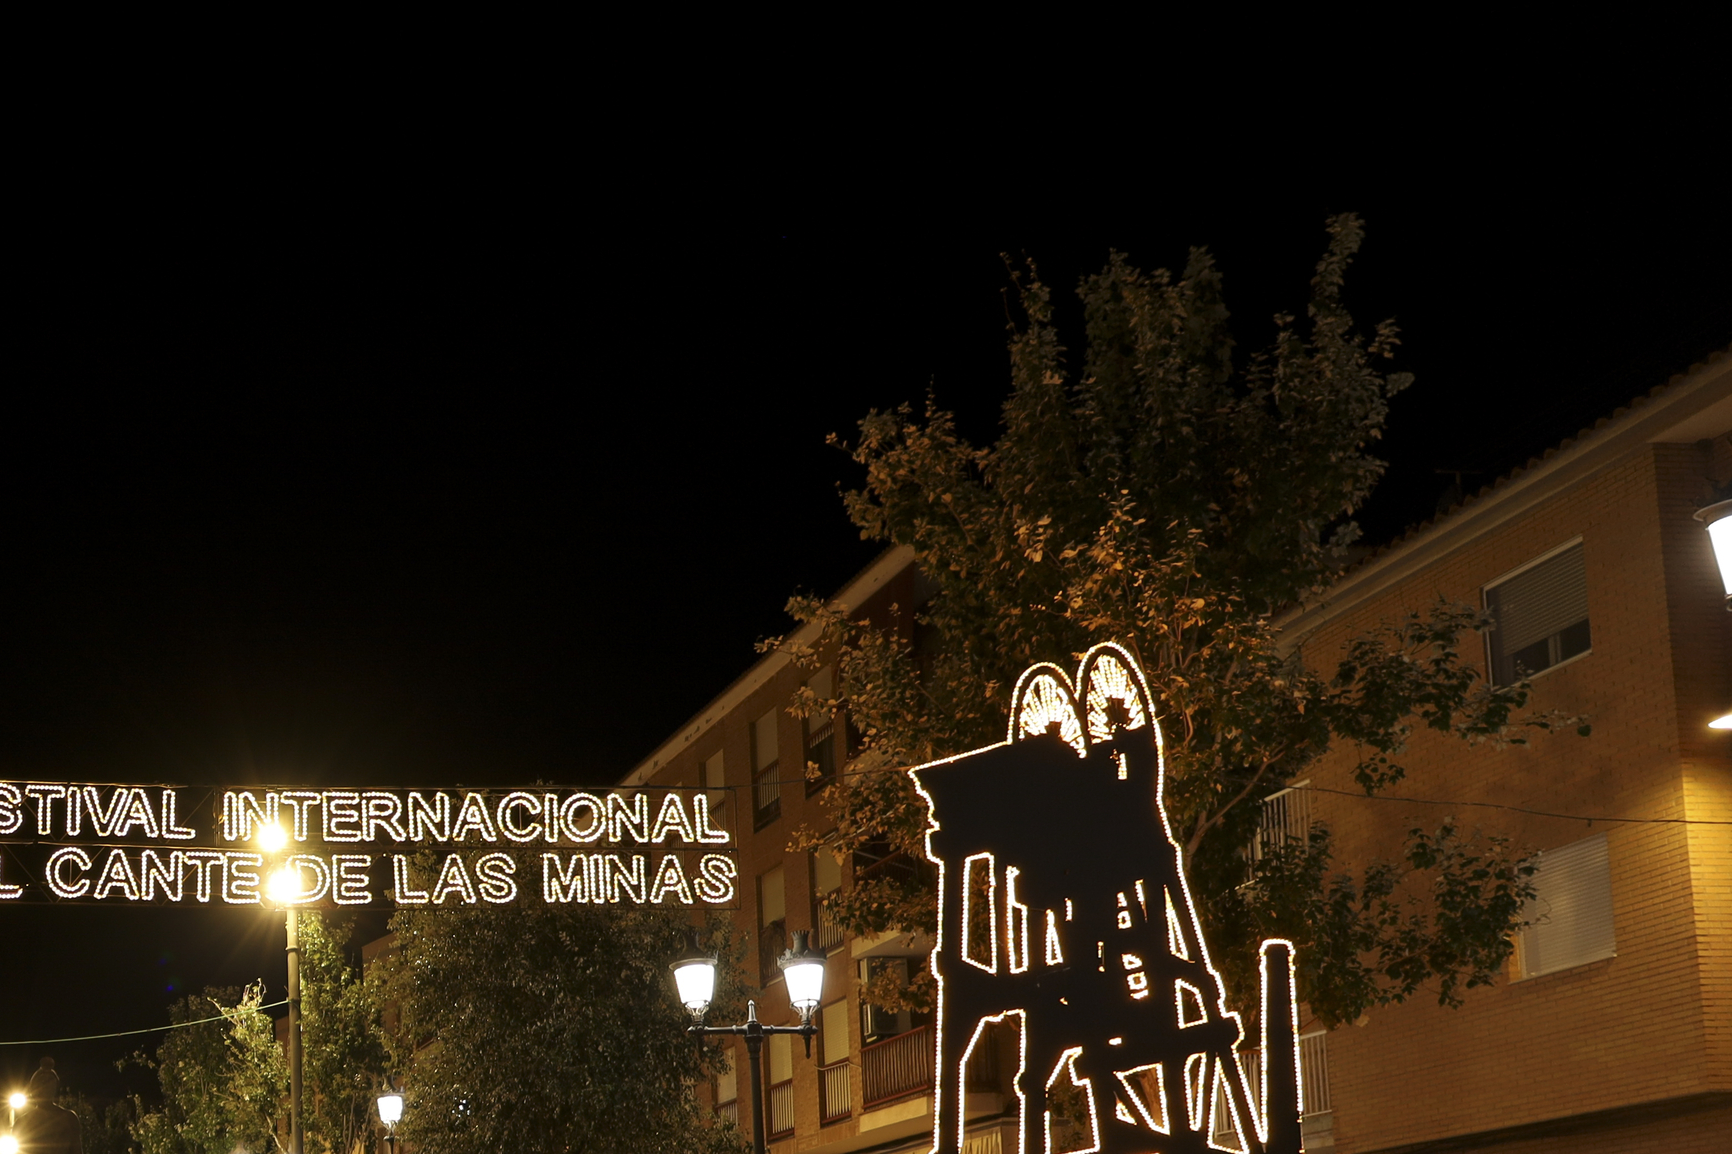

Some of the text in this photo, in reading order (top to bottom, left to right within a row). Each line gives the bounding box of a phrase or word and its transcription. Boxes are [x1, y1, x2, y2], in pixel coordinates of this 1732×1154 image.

[223, 790, 730, 843] INTERNACIONAL
[45, 846, 263, 904] CANTE
[284, 853, 373, 905] DE
[393, 852, 518, 904] LAS
[543, 853, 737, 904] MINAS
